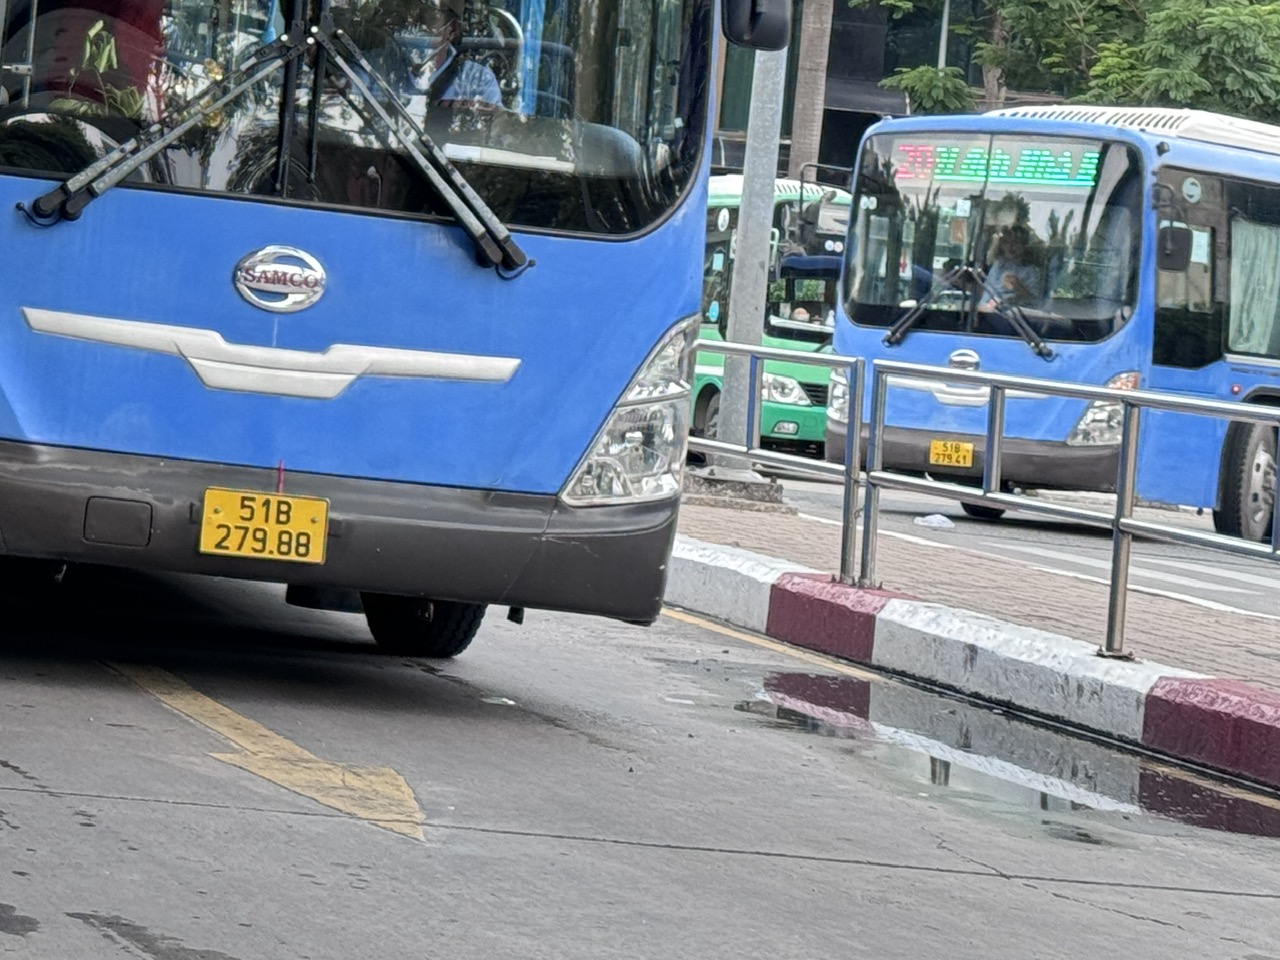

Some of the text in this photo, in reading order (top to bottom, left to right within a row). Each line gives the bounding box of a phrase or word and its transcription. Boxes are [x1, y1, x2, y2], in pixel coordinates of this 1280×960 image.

[243, 267, 320, 289] SAMCO
[942, 441, 961, 454] 51B
[239, 496, 293, 525] 51B
[214, 523, 312, 558] 279.88
